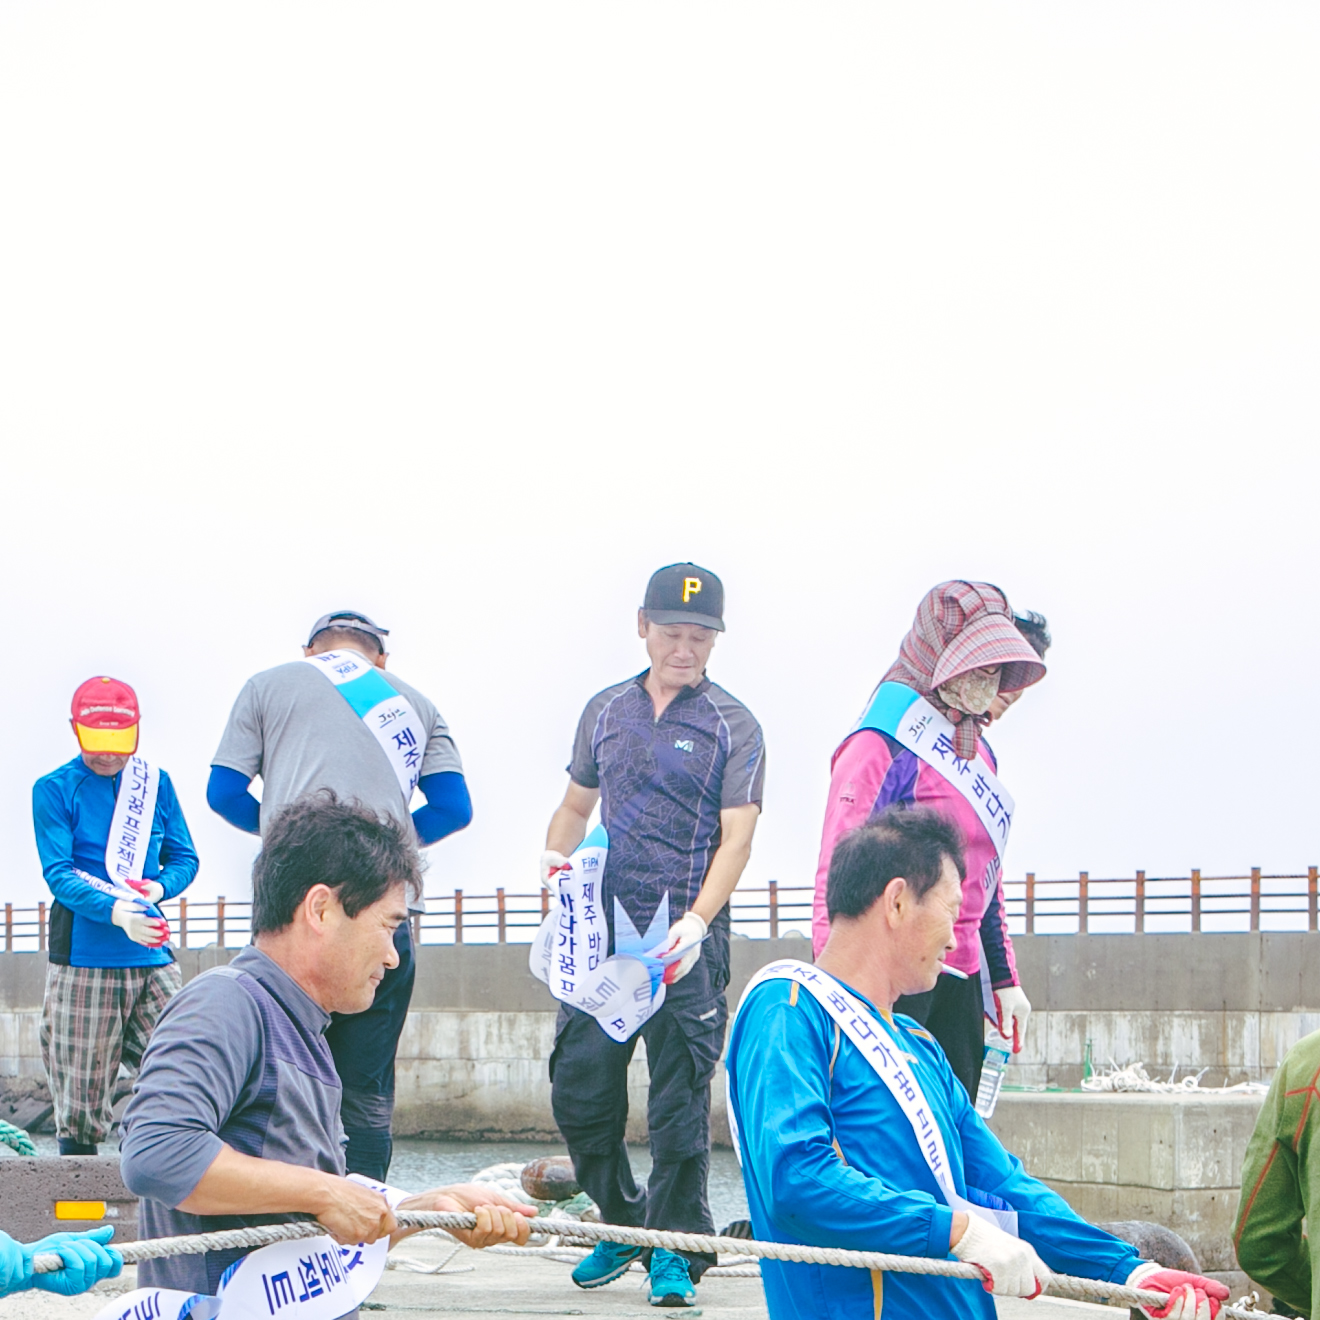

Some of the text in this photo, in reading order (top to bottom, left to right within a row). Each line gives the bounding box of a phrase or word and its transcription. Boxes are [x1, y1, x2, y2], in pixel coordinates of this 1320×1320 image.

[683, 577, 702, 603] P
[908, 715, 927, 737] Jeju
[392, 727, 421, 769] 제주
[932, 733, 971, 775] 제주
[581, 882, 597, 925] 제주
[827, 990, 916, 1102] 바다가꿈
